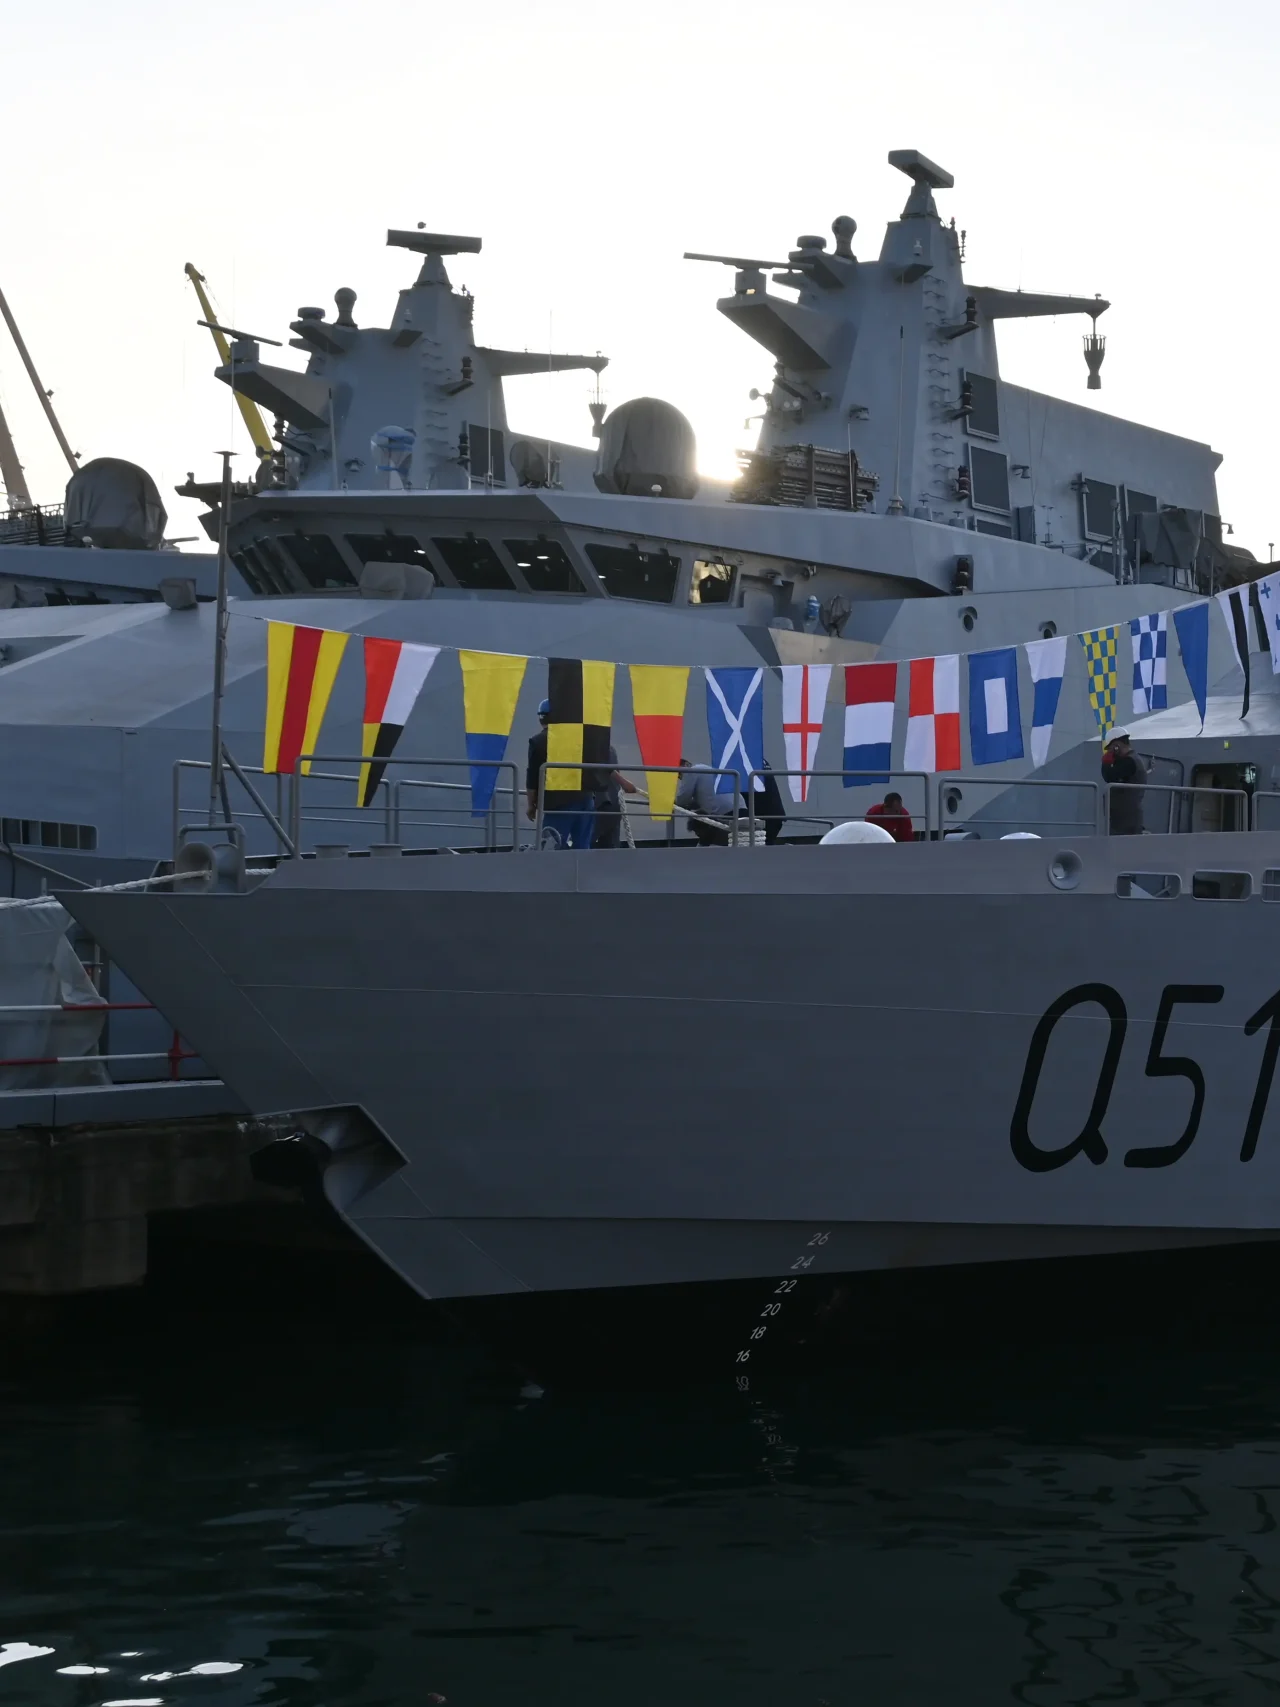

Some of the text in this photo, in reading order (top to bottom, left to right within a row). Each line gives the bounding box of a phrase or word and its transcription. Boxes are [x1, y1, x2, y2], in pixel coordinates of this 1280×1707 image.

[807, 1232, 831, 1246] 26
[790, 1255, 815, 1269] 24
[774, 1280, 797, 1293] 22
[760, 1303, 781, 1316] 20
[750, 1326, 767, 1339] 18
[736, 1349, 750, 1362] 16
